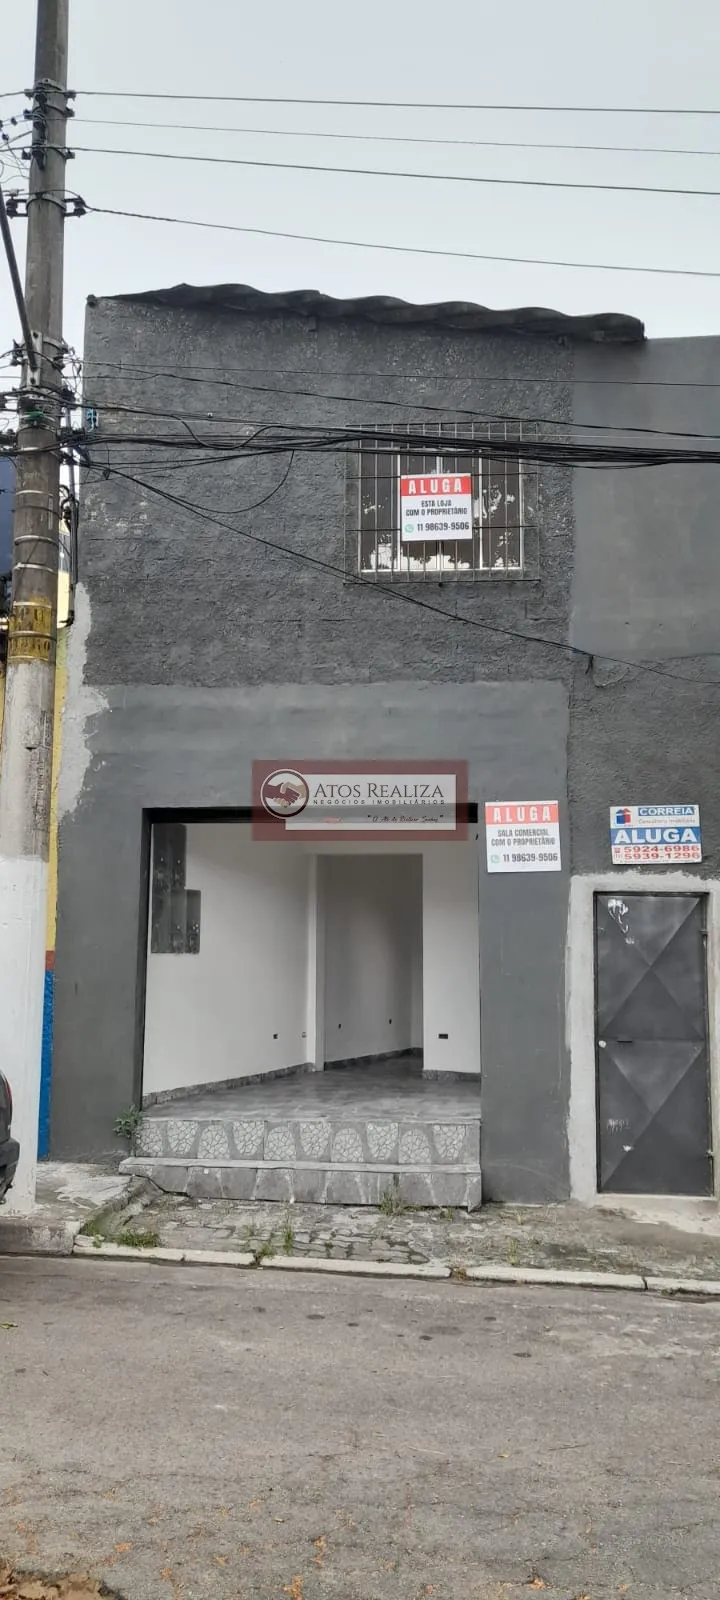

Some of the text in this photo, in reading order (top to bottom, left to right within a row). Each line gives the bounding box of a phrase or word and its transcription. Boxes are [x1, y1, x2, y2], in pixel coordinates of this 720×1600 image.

[408, 478, 462, 494] ALUGA
[437, 499, 452, 507] LOJA
[421, 508, 425, 516] O
[427, 506, 468, 516] PROPRIETÁRIO
[417, 521, 469, 532] 11 98639-9506
[493, 806, 551, 823] ALUGA
[639, 807, 693, 816] CORREIA
[497, 828, 549, 837] SALA COMERCIAL
[614, 828, 698, 844] ALUGA
[507, 838, 511, 846] O
[513, 836, 556, 846] PROPRIETÁRIO
[503, 853, 558, 863] 11 98639-9506
[624, 852, 700, 860] 5939-1296
